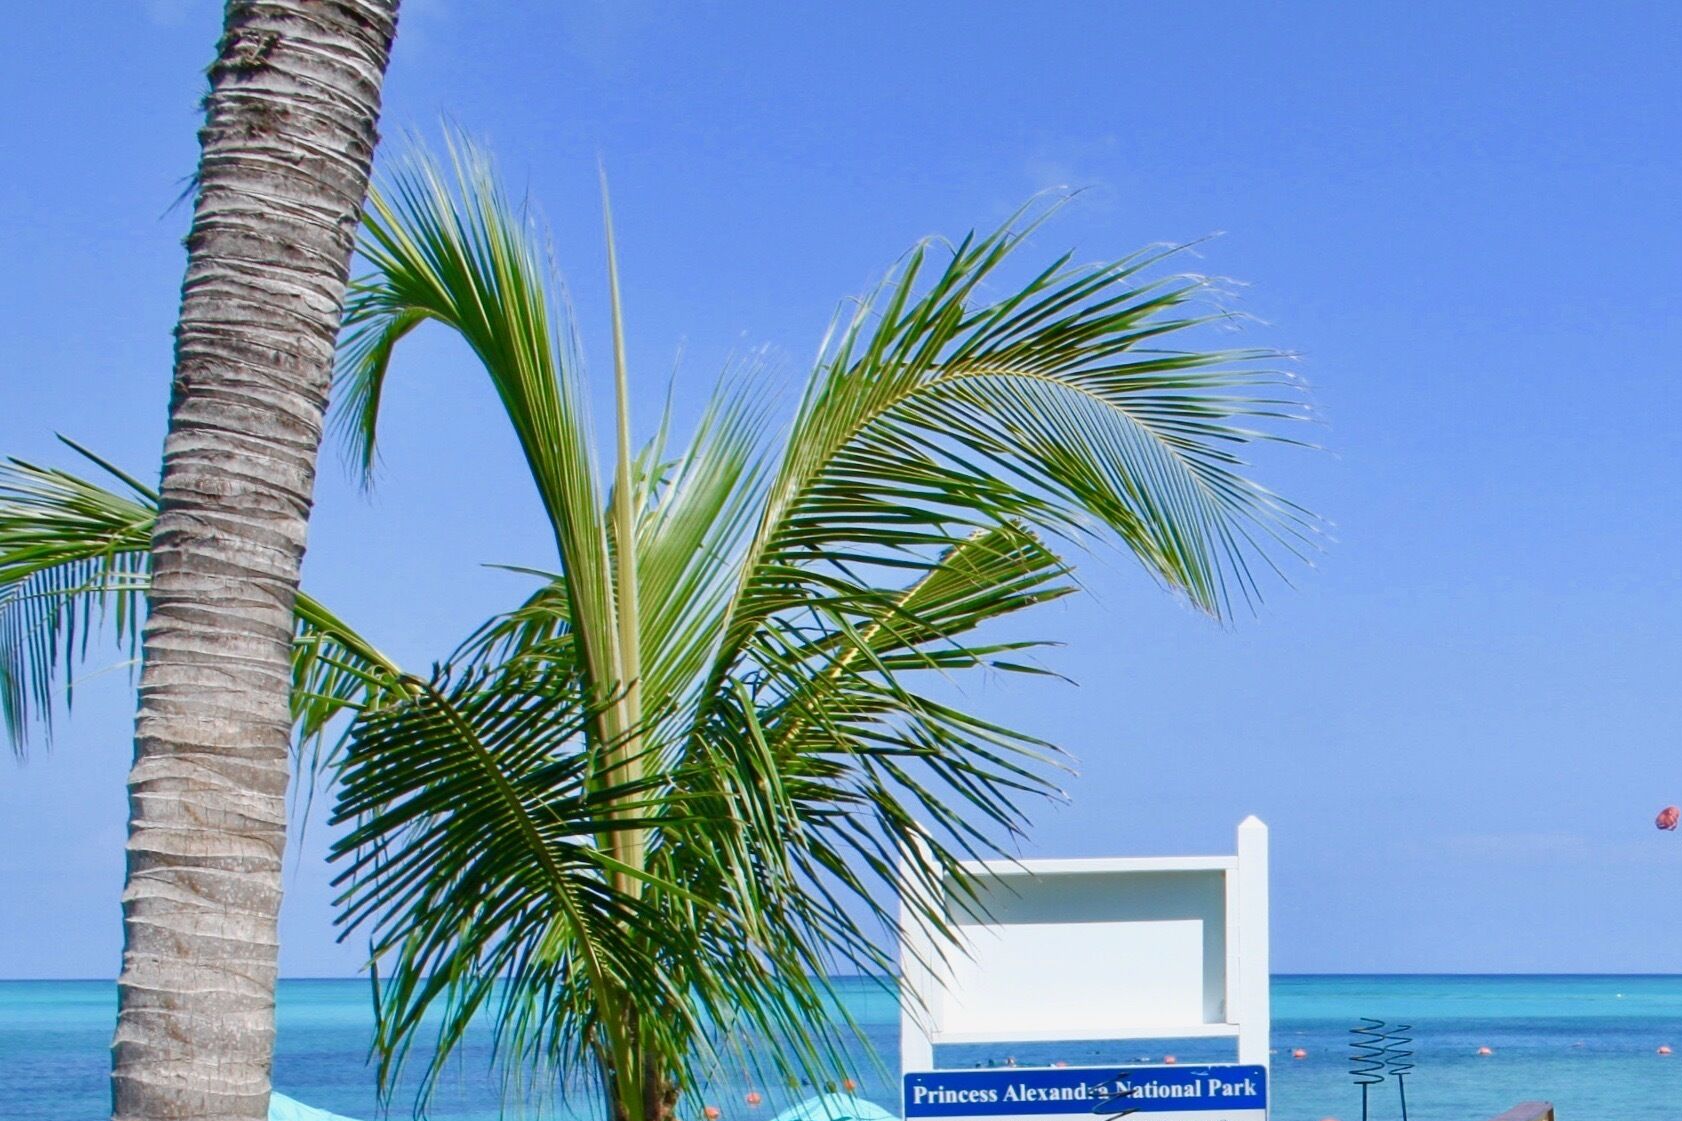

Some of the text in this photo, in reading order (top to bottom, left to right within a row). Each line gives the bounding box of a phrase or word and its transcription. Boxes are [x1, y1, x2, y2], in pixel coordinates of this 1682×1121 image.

[912, 1085, 998, 1104] Princess
[1115, 1079, 1202, 1099] National
[1207, 1078, 1257, 1097] Park
